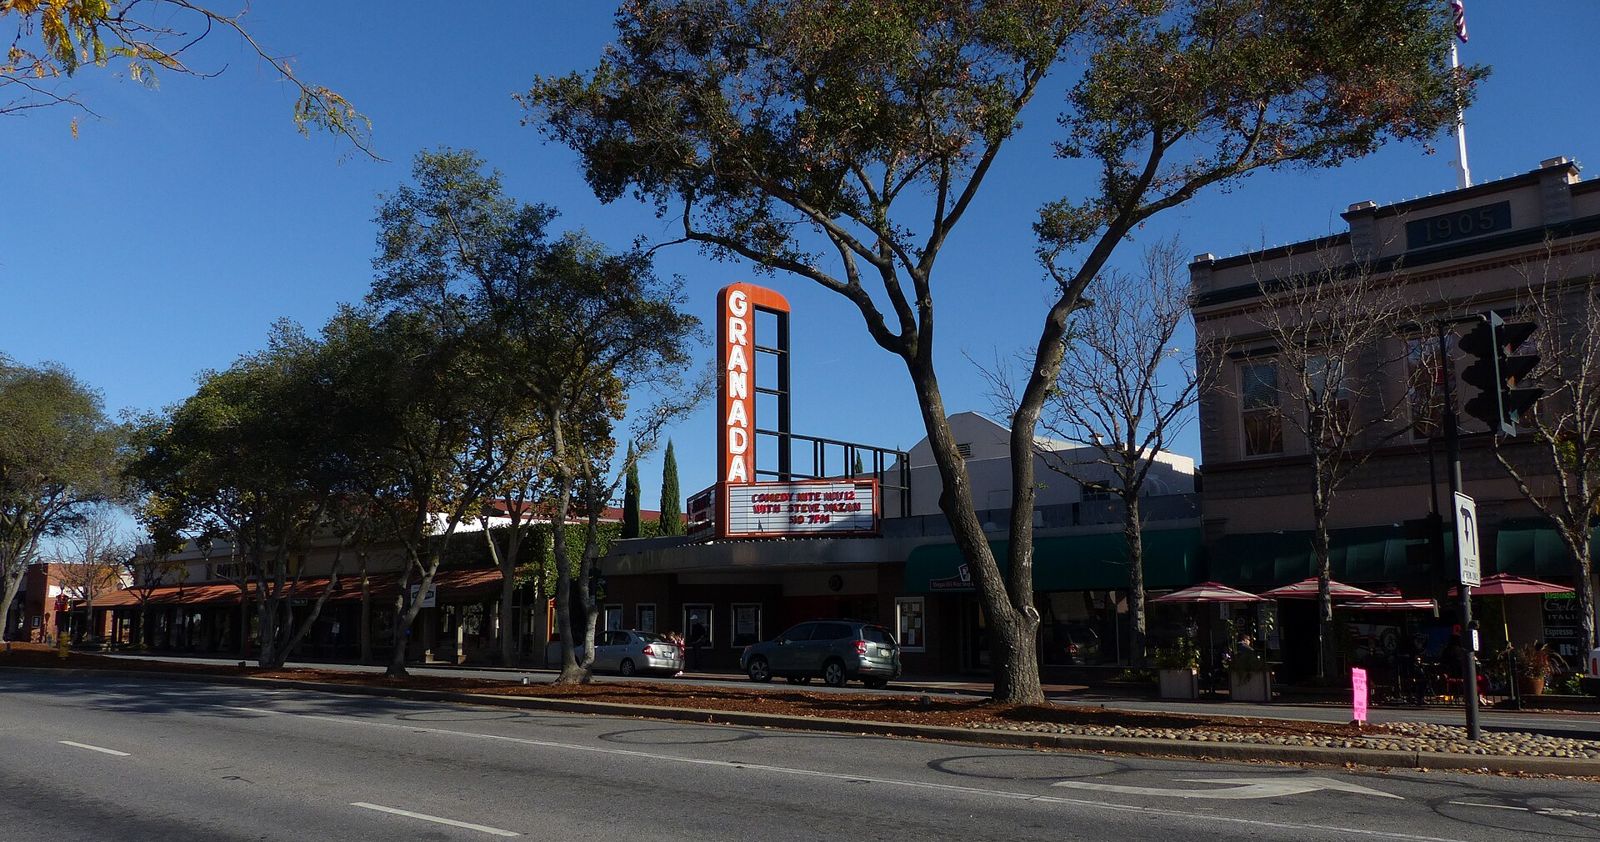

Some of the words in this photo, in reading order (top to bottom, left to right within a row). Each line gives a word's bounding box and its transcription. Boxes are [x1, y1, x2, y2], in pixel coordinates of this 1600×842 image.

[1424, 208, 1495, 242] 1905
[727, 290, 748, 481] GRANADA
[751, 492, 794, 503] COMEDY
[796, 492, 821, 502] NITE
[752, 503, 781, 514] WITH
[787, 503, 821, 513] STEVE
